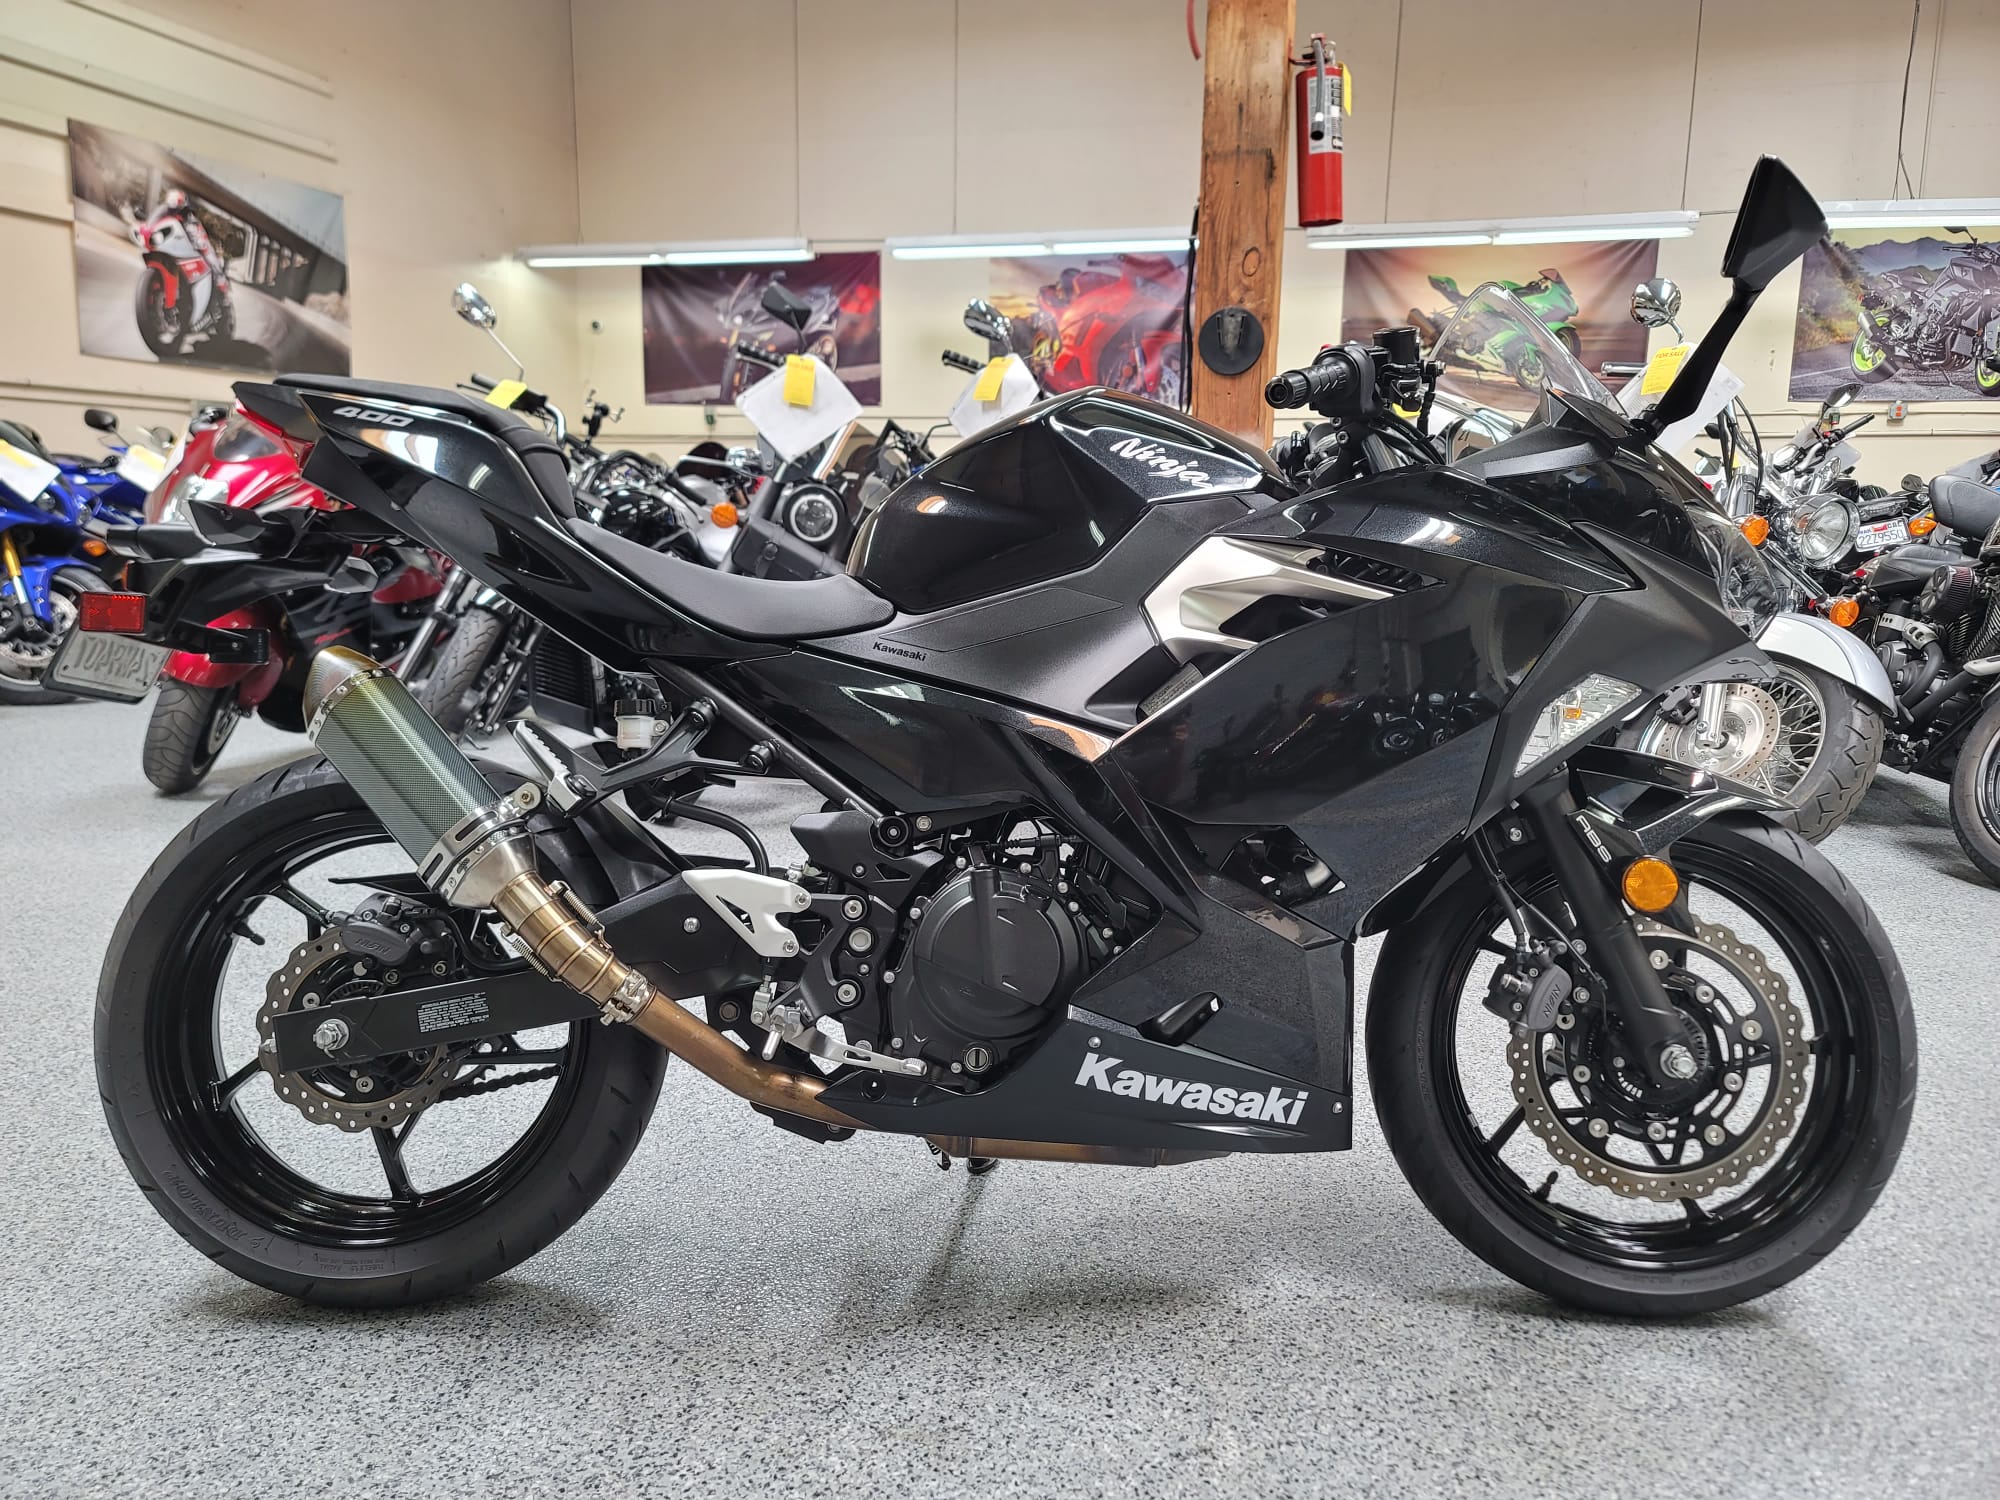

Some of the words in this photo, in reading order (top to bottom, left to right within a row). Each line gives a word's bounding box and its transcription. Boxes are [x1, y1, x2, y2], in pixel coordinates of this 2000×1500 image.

[1669, 350, 1685, 358] SALE
[332, 405, 415, 428] 400
[1109, 437, 1214, 490] Ninja
[872, 641, 928, 662] Kawasaki
[1575, 814, 1613, 863] ABS
[1074, 1051, 1309, 1126] Kawasaki
